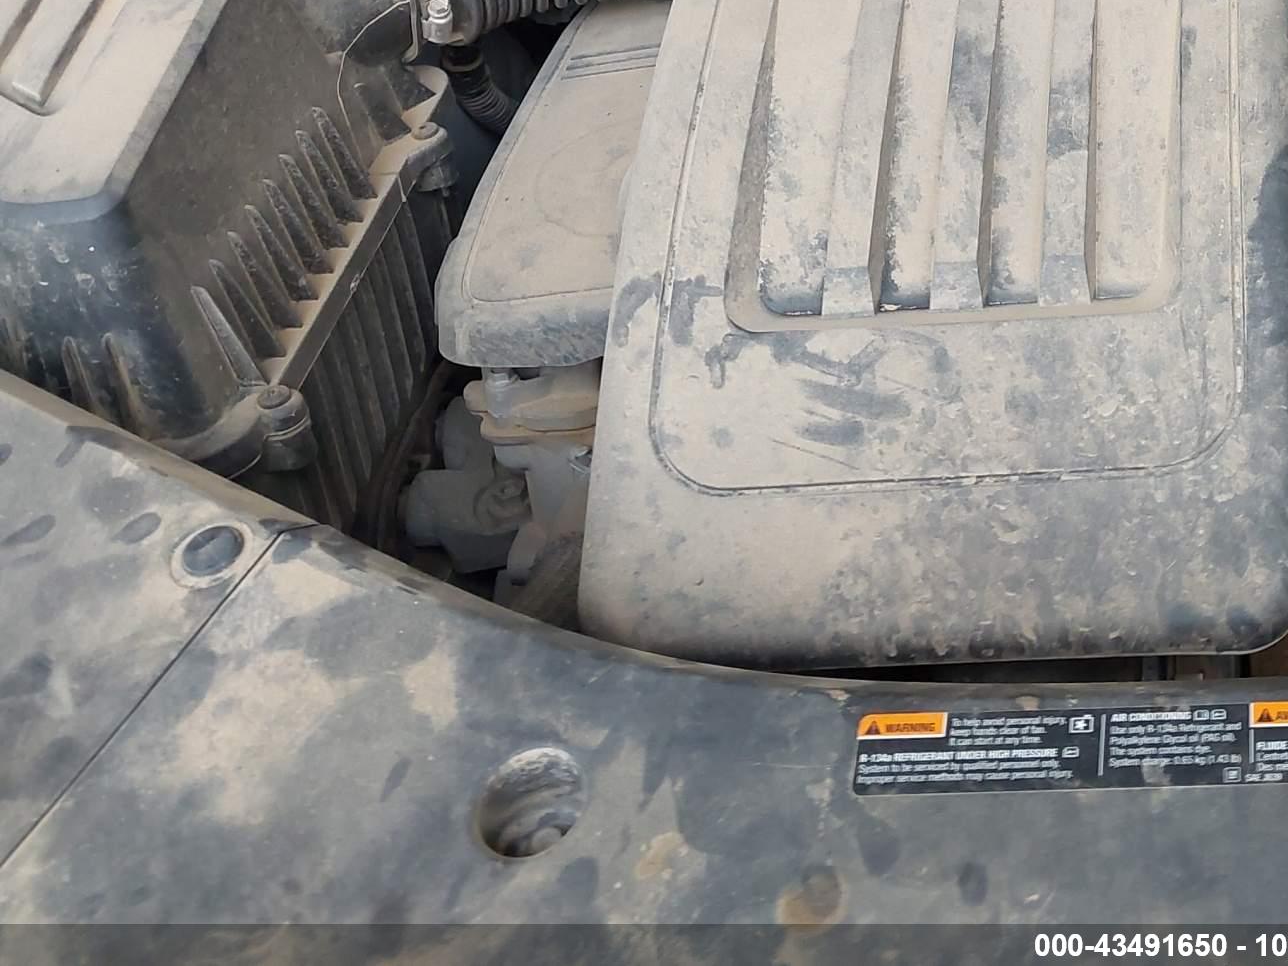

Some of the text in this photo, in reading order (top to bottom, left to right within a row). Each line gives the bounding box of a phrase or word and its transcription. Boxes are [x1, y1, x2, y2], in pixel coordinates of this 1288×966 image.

[963, 718, 981, 728] help
[982, 716, 1005, 726] avoid
[1006, 716, 1041, 725] personal
[1111, 711, 1192, 722] AIR CONDITIONING
[886, 722, 936, 733] WARNING
[999, 725, 1020, 735] clear
[974, 737, 995, 745] start
[1256, 740, 1288, 750] FLUIDE
[893, 751, 954, 762] REFRIGERANT
[955, 750, 986, 760] UNDER
[988, 749, 1010, 759] HIGH
[1012, 747, 1059, 758] PRESSURE
[1110, 746, 1126, 755] The
[1126, 746, 1158, 756] system
[1109, 757, 1141, 768] System
[858, 764, 889, 775] System
[1244, 774, 1262, 782] SAE
